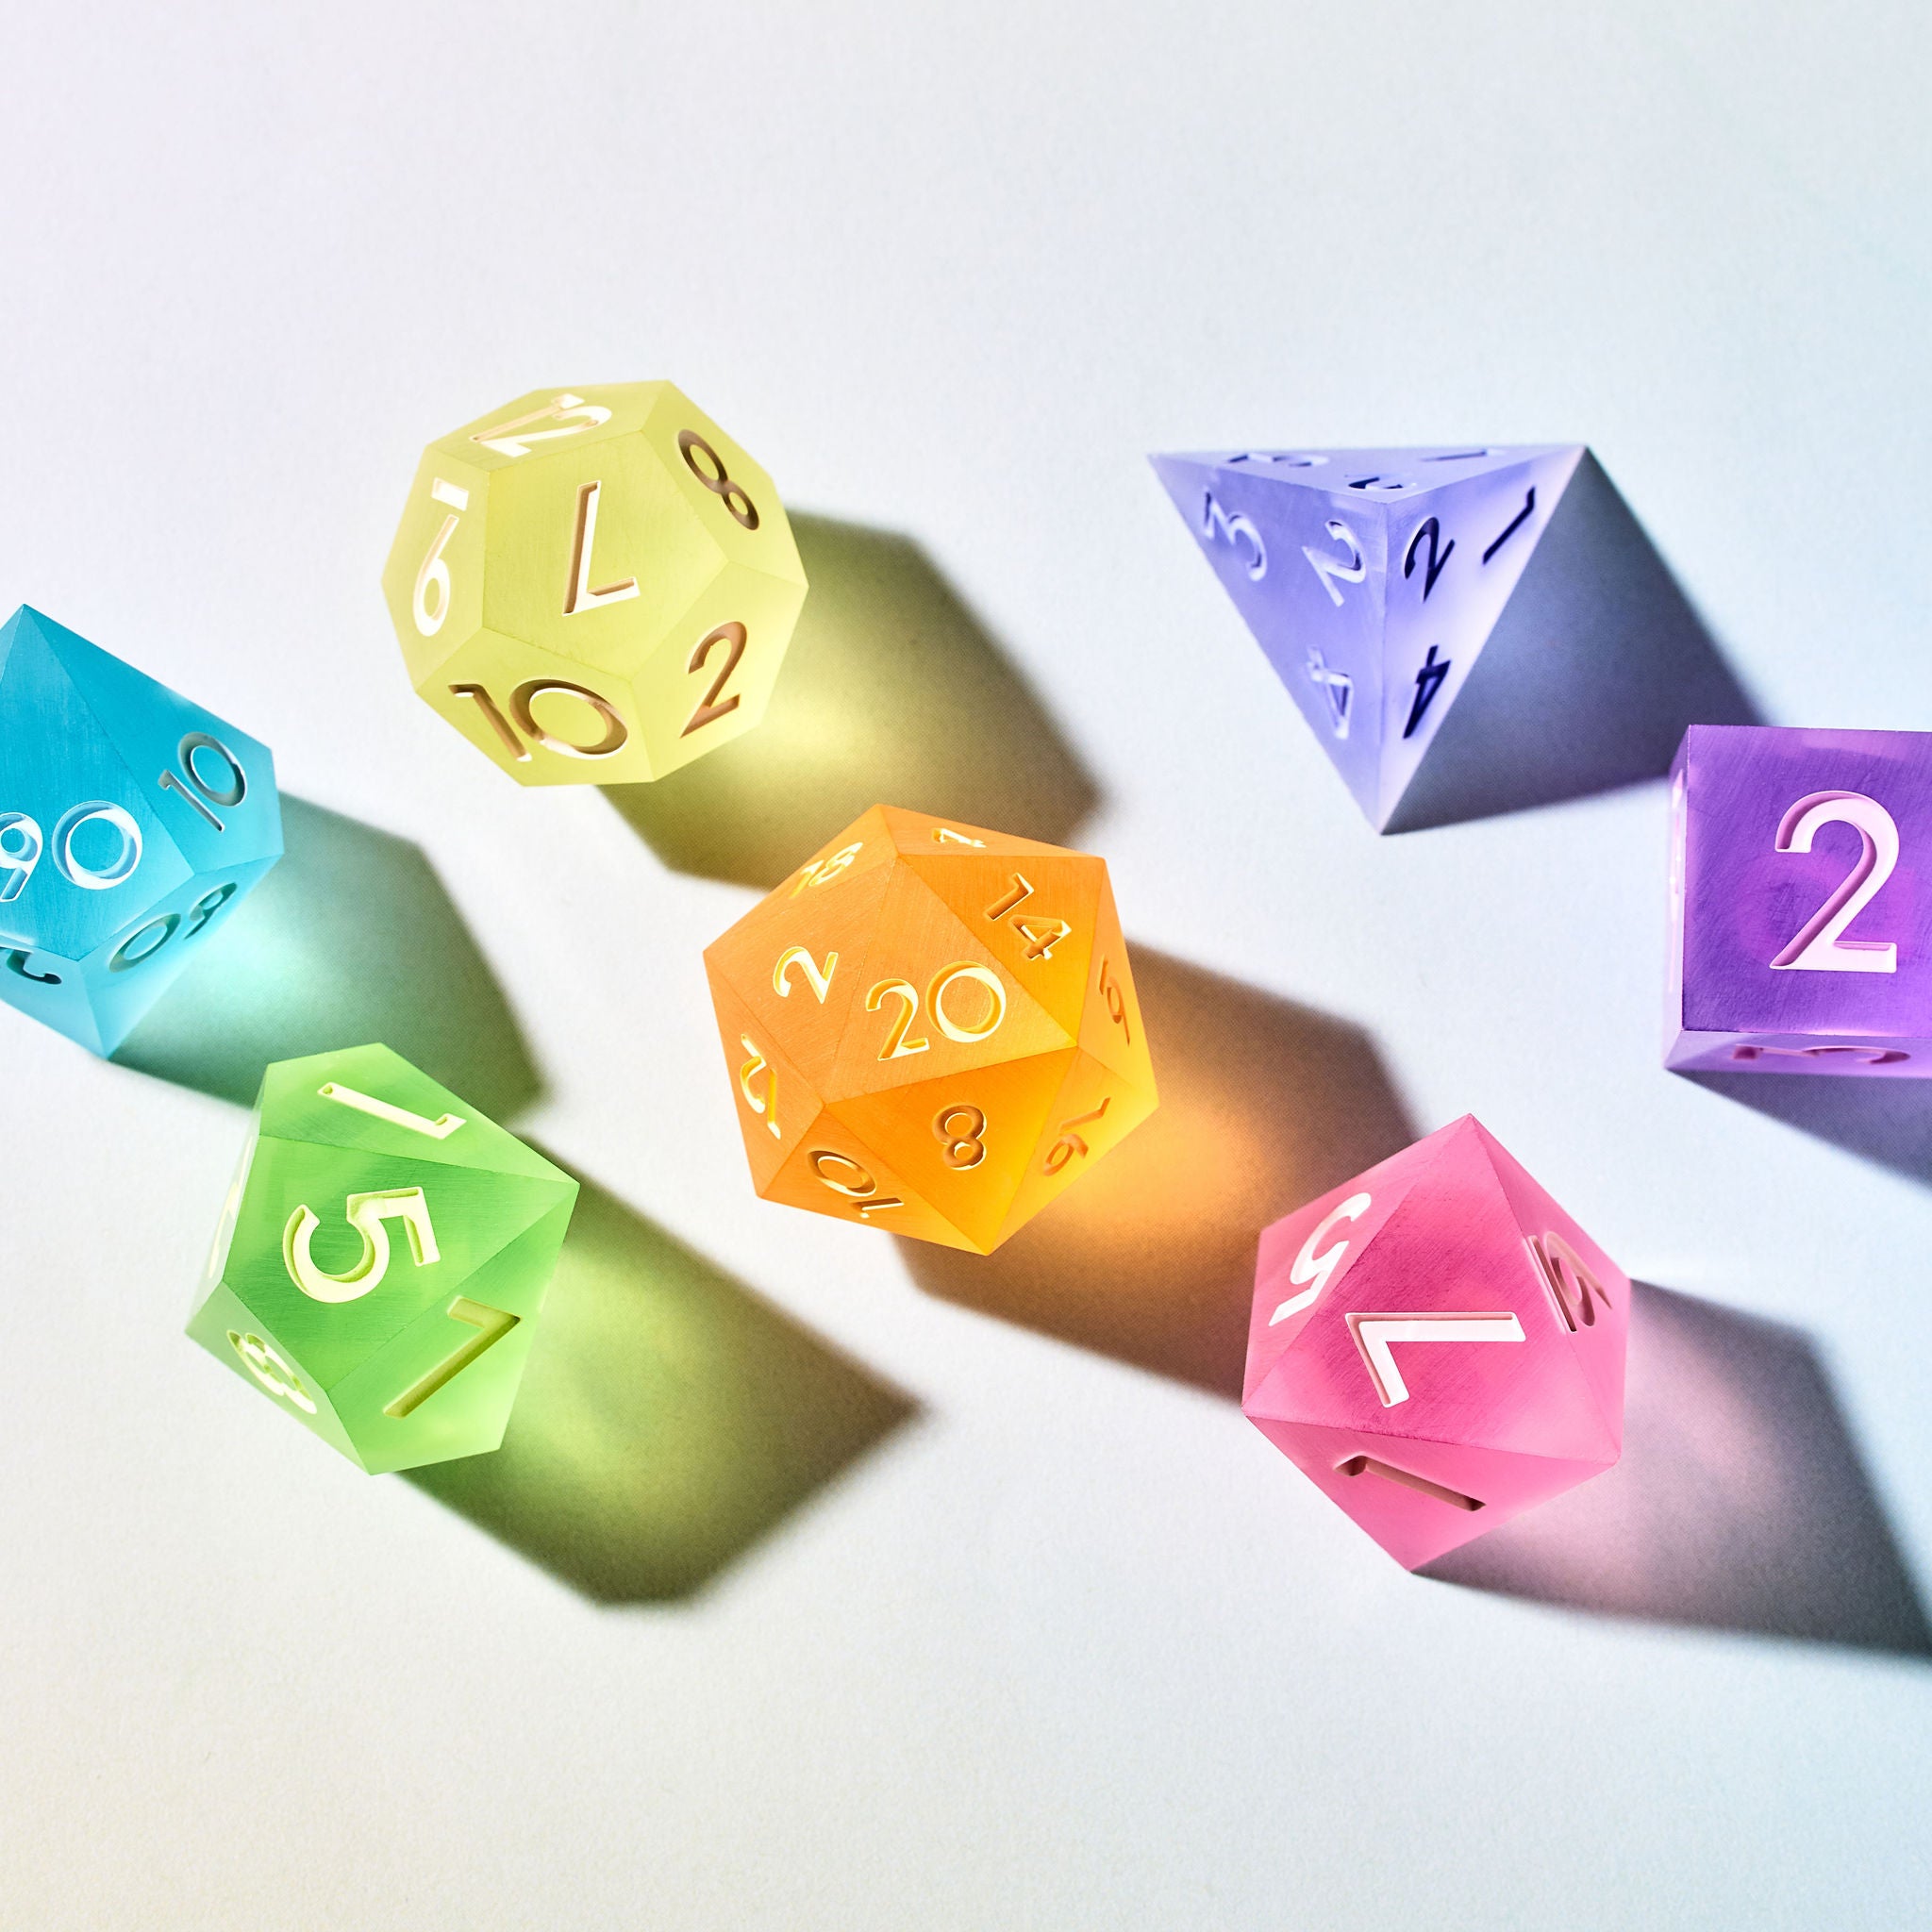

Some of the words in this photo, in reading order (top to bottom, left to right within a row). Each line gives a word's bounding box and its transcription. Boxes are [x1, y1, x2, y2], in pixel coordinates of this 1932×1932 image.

[677, 428, 760, 531] 8
[1483, 485, 1537, 566] 1
[562, 479, 641, 617] 7
[1203, 486, 1268, 582] 3
[1302, 520, 1366, 607] 2
[1403, 516, 1455, 604] 2
[448, 677, 628, 762] 10
[679, 621, 747, 739] 2
[1307, 643, 1355, 741] 4
[1403, 644, 1452, 740] 4
[158, 731, 247, 832] 10
[0, 800, 143, 903] 90
[789, 841, 864, 900] 18
[1770, 790, 1900, 974] 2
[983, 873, 1073, 961] 14
[773, 945, 839, 1005] 2
[865, 960, 1007, 1061] 20
[739, 1033, 782, 1140] 12
[808, 1148, 905, 1219] 10
[932, 1104, 988, 1171] 8
[283, 1186, 441, 1304] 5
[1268, 1191, 1373, 1327] 5
[383, 1295, 521, 1419] 7
[1345, 1311, 1527, 1408] 7
[1333, 1451, 1488, 1513] 1
